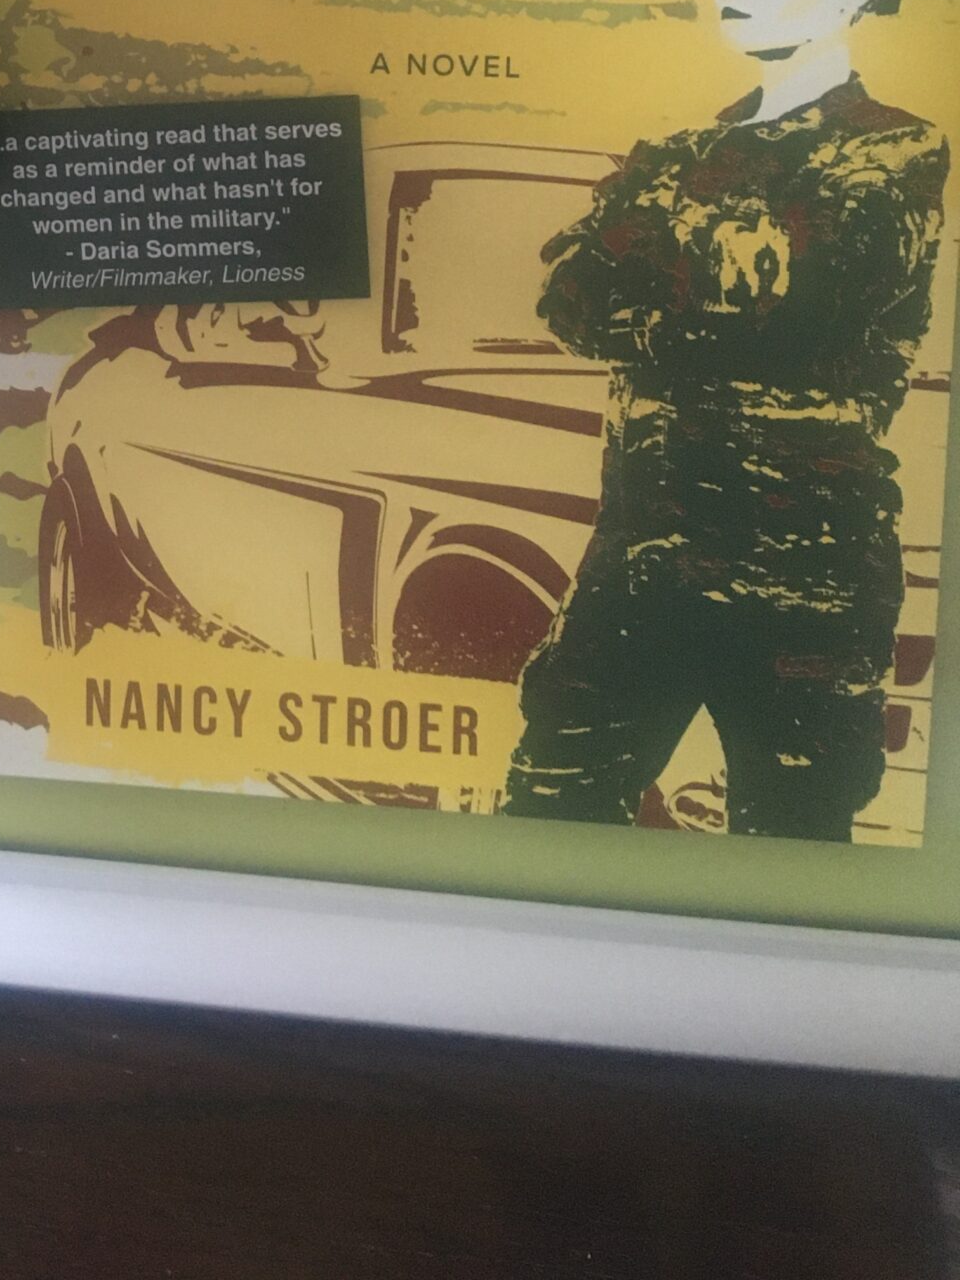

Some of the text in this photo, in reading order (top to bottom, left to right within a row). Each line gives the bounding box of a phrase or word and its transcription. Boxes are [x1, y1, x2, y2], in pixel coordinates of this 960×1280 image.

[370, 53, 520, 78] A NOVEL
[24, 127, 149, 155] captivating
[155, 126, 209, 145] read
[213, 122, 258, 142] that
[264, 122, 342, 139] serves
[12, 150, 306, 179] as a reminder of what has
[0, 177, 323, 211] changed and what hasn't for
[32, 207, 291, 235] women in the military."
[81, 240, 139, 262] Daria
[146, 239, 262, 260] Sommers,
[31, 264, 306, 290] Writer/Filmmaker, Lioness
[85, 677, 479, 757] NANCY STROER
